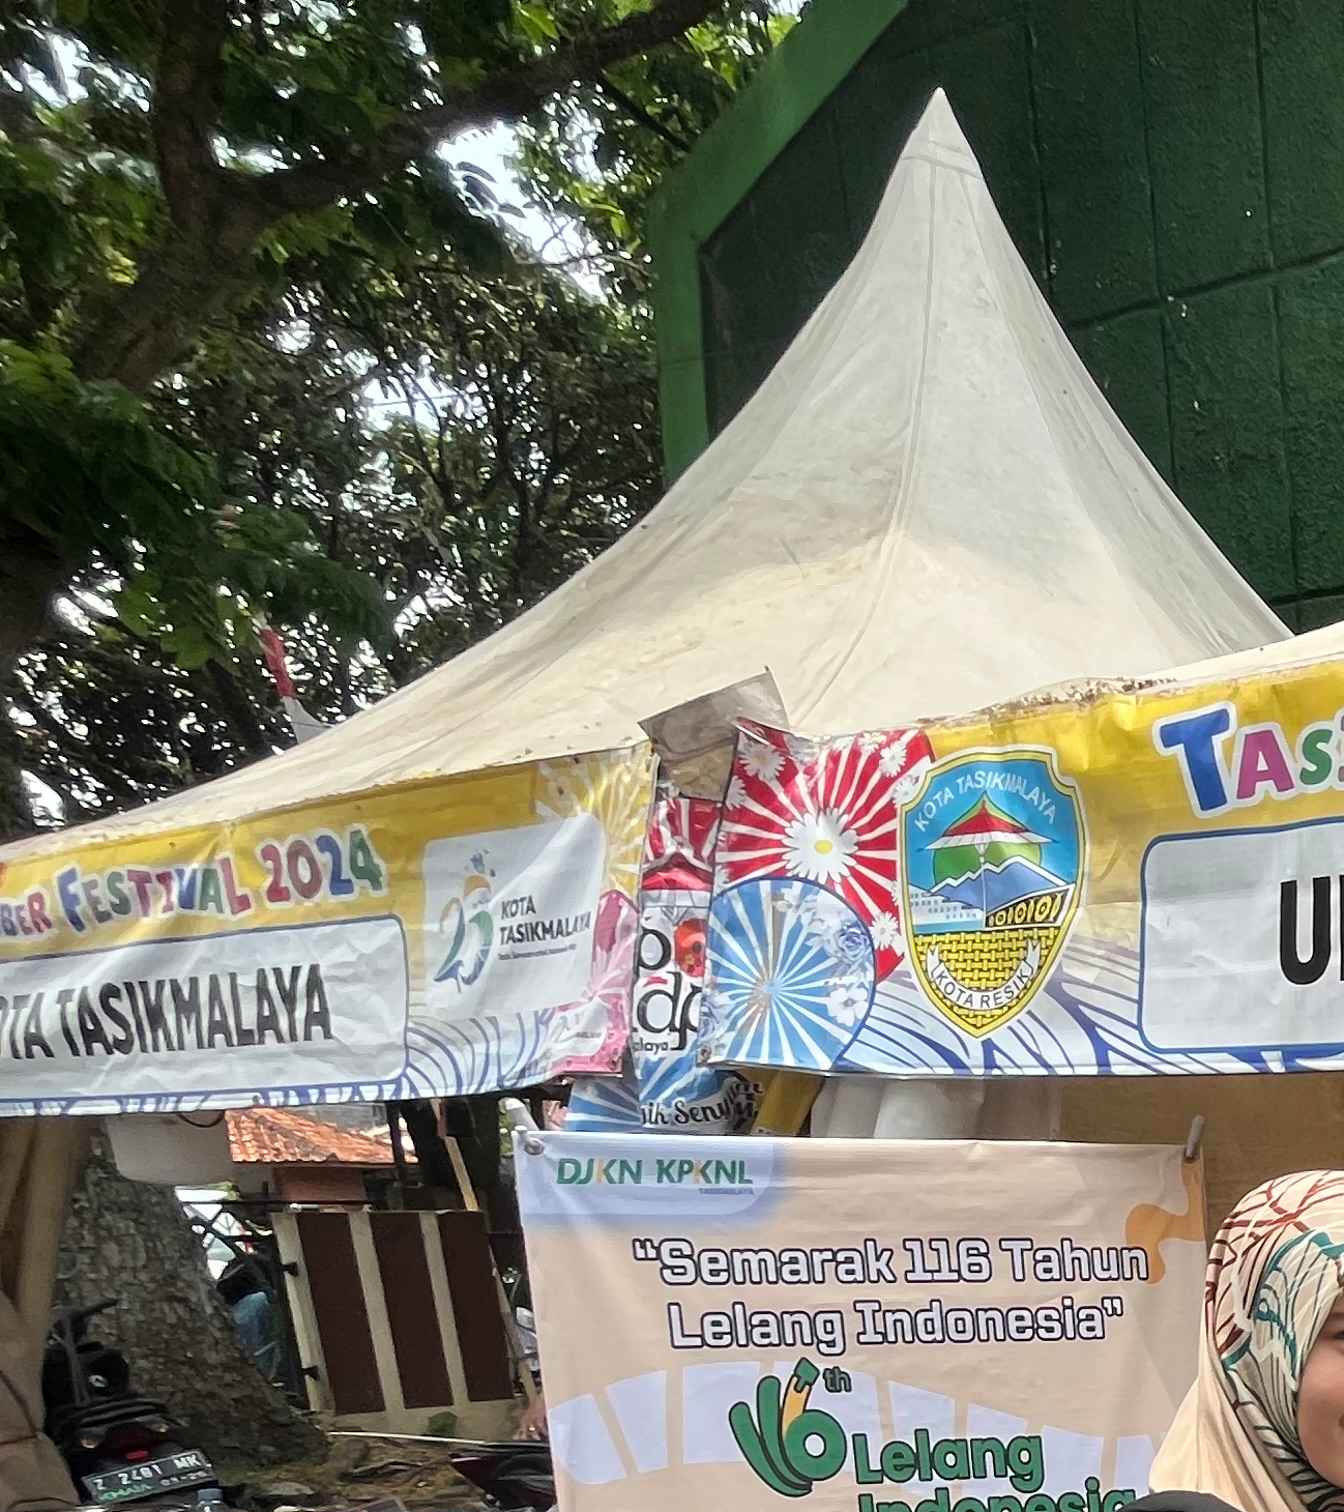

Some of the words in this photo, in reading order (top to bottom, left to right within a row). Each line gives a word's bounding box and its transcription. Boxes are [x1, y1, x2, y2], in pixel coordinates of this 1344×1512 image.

[914, 787, 954, 832] KOTA
[955, 768, 1057, 825] TASIKMALAYA
[57, 857, 252, 933] FESTIVAL
[260, 829, 384, 903] 2024
[501, 895, 537, 920] KOTA
[56, 963, 333, 1056] TASIKMALAYA
[935, 970, 978, 1010] KOTA
[979, 970, 1030, 1010] RESIK
[556, 1158, 643, 1185] DJKN
[656, 1158, 754, 1185] KPKNL
[903, 1237, 992, 1282] 116
[999, 1236, 1149, 1281] Tahun
[667, 1302, 846, 1356] Lelang
[850, 1428, 1046, 1494] Lelang
